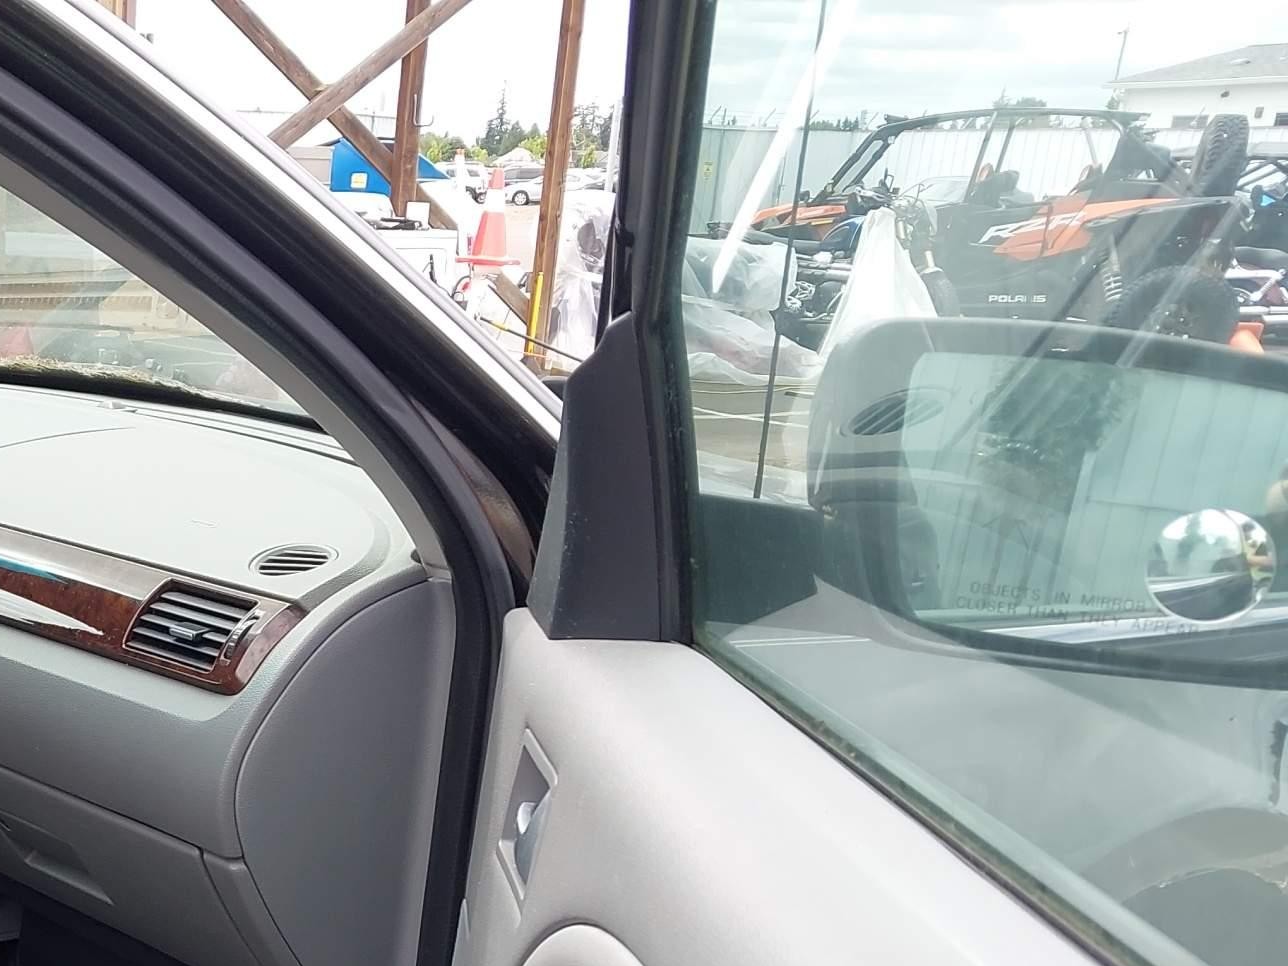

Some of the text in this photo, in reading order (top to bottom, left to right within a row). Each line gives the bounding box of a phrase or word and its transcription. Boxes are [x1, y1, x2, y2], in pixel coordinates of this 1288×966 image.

[988, 294, 1047, 303] POLAIS
[956, 596, 1017, 614] CLOSER
[1028, 605, 1069, 621] THAN
[1080, 611, 1121, 628] THEY
[969, 581, 1146, 613] OBJECTS IN MIRROR
